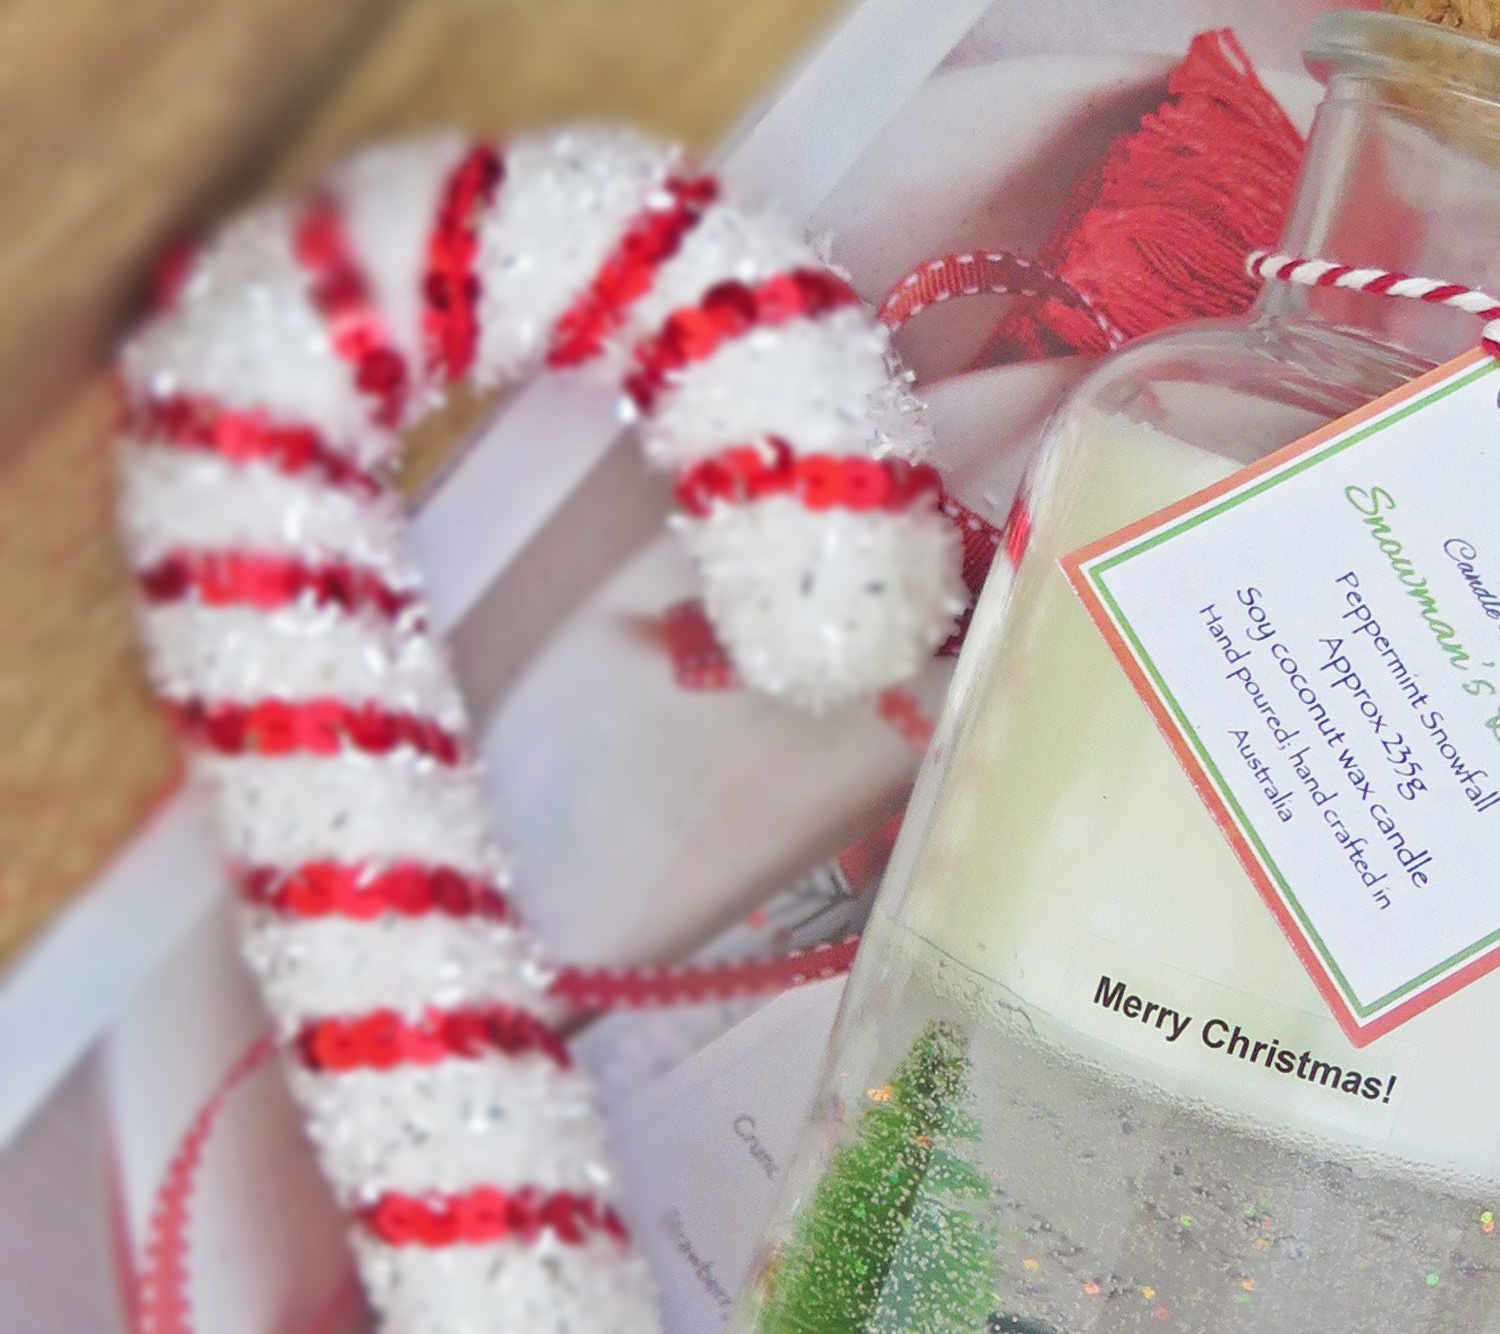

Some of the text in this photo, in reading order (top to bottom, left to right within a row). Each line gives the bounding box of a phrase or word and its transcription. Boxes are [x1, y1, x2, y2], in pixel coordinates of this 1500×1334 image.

[1334, 570, 1430, 711] Peppermint
[1344, 484, 1498, 697] Snowman's
[1198, 603, 1392, 911] Hand poured; hand crafted in
[1227, 730, 1295, 824] Australia
[1236, 586, 1434, 889] Soy coconut wax candle
[1318, 637, 1430, 802] Approx 235g
[1092, 975, 1398, 1105] Merry Christmas!
